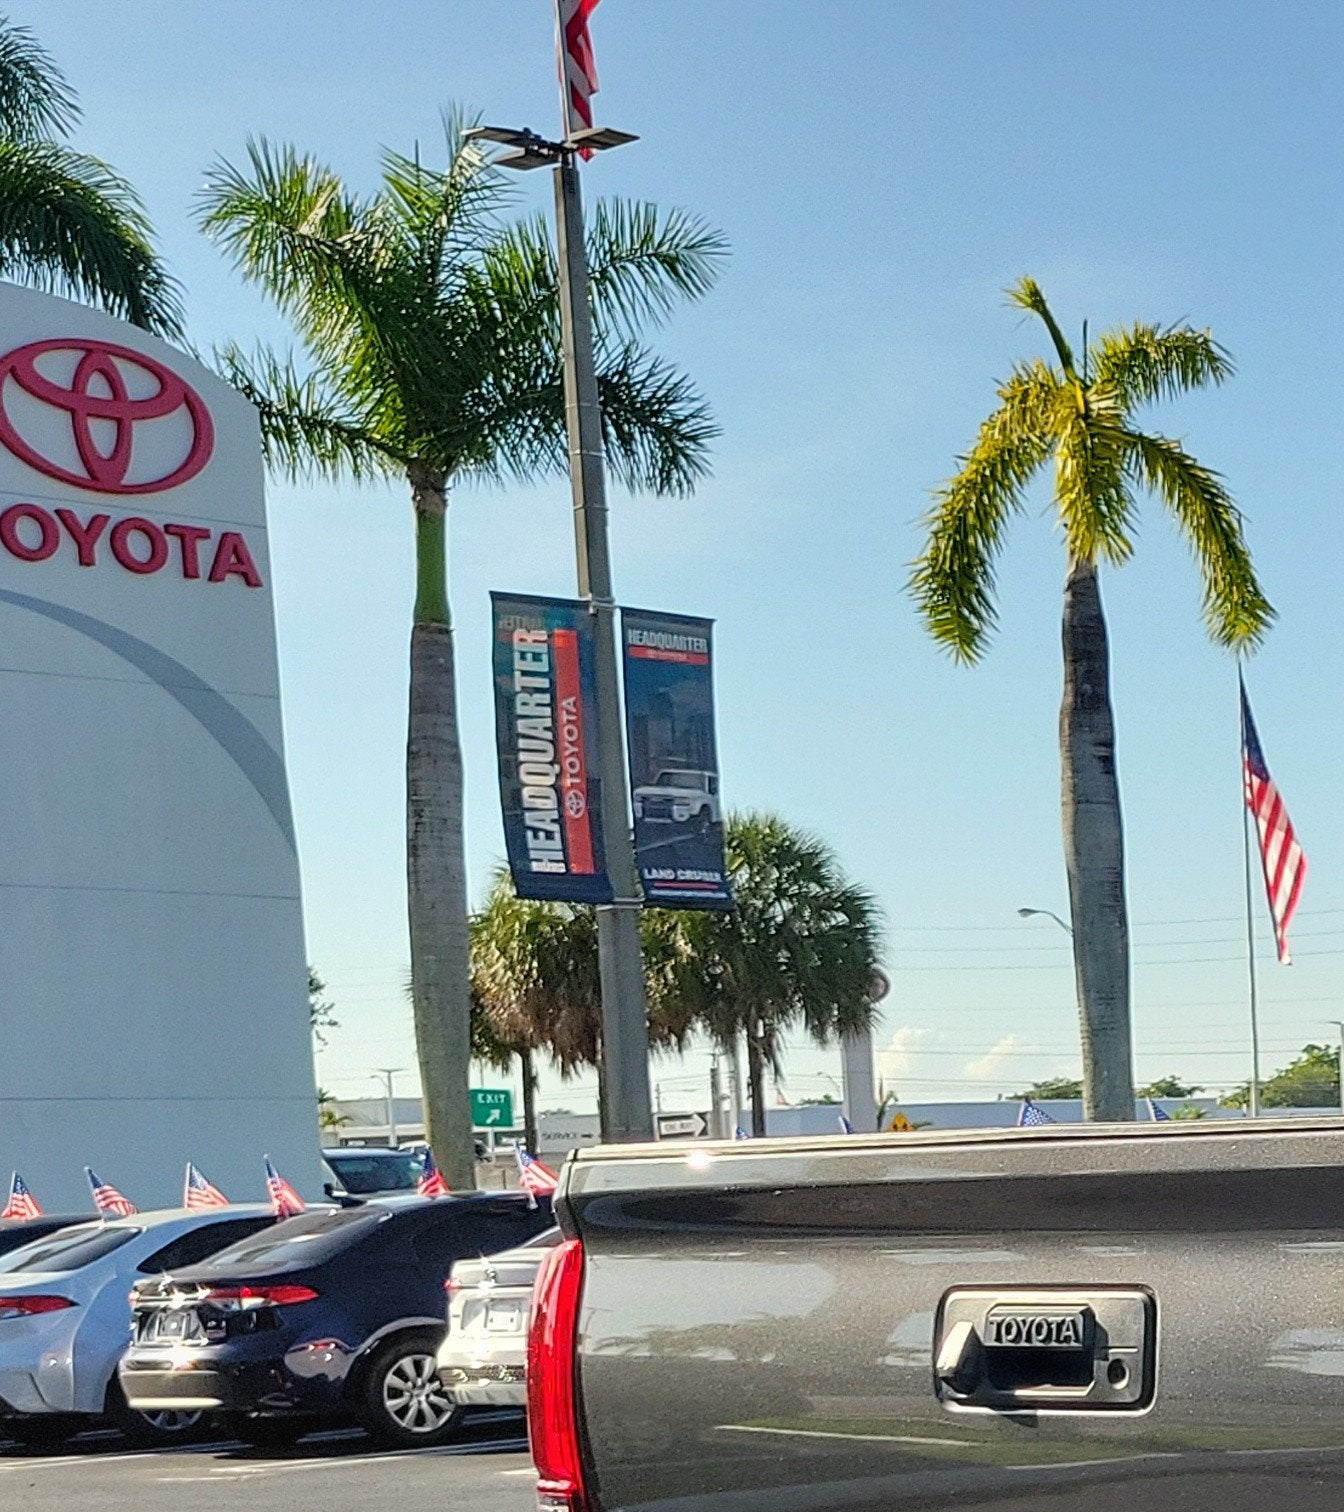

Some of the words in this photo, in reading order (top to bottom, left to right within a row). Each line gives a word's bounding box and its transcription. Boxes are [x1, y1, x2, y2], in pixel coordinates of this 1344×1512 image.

[0, 503, 263, 588] OYOTA
[627, 628, 709, 654] HEADQUARTER
[511, 628, 566, 874] HEADQUARTER
[558, 696, 585, 787] TOYOTA
[643, 867, 676, 880] LAND
[477, 1093, 507, 1104] EXIT
[985, 1315, 1082, 1345] TOYOTA
